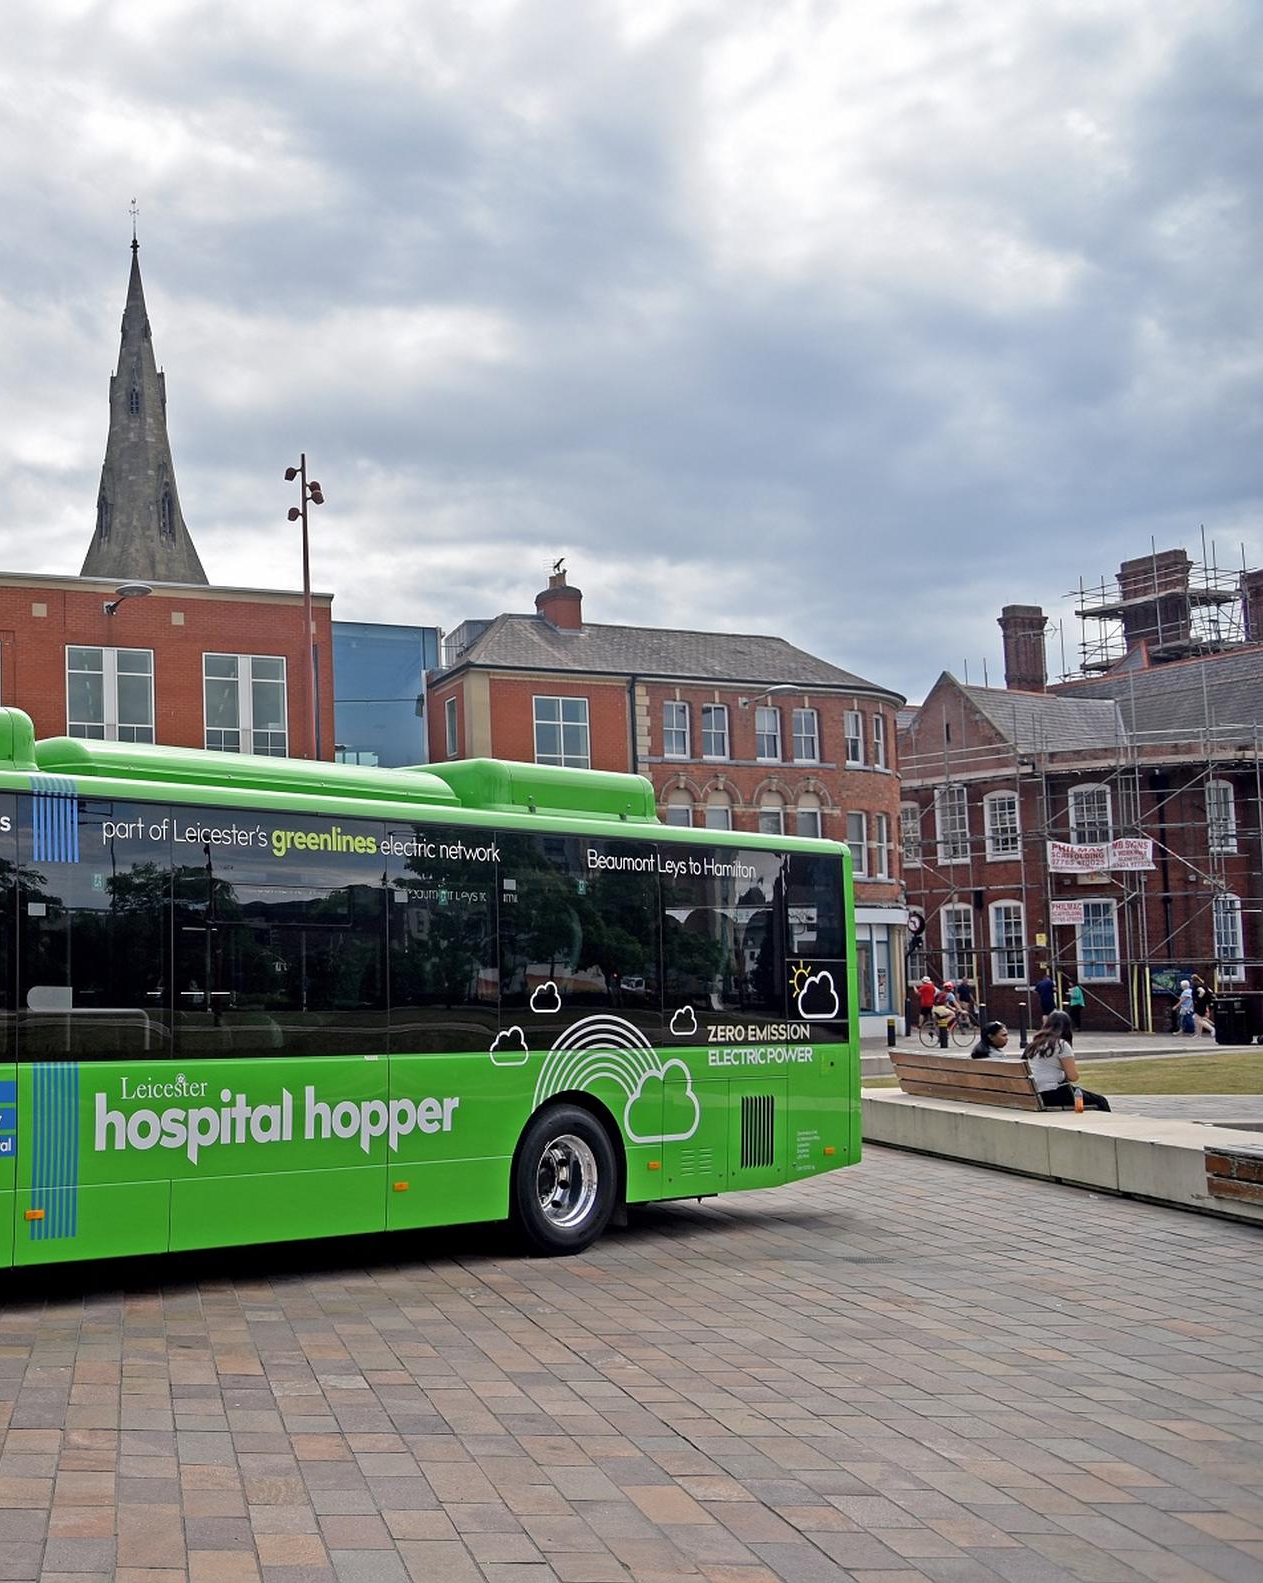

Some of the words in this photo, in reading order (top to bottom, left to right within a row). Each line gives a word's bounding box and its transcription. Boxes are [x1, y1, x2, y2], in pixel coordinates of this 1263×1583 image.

[102, 817, 145, 846] part
[148, 819, 170, 841] of
[173, 822, 268, 848] Leicester's
[272, 826, 377, 856] greenlines
[381, 837, 436, 859] electric
[439, 840, 501, 864] network
[588, 849, 655, 872] Beaumont
[657, 858, 686, 878] Leys
[688, 860, 701, 875] to
[704, 861, 756, 878] Hamilton
[707, 1024, 745, 1043] ZERO
[748, 1023, 810, 1041] EMISSION
[708, 1049, 766, 1066] ELECTRIC
[767, 1047, 813, 1064] POWER
[120, 1076, 208, 1100] Leicester
[94, 1086, 293, 1166] hospital
[304, 1085, 460, 1155] hopper
